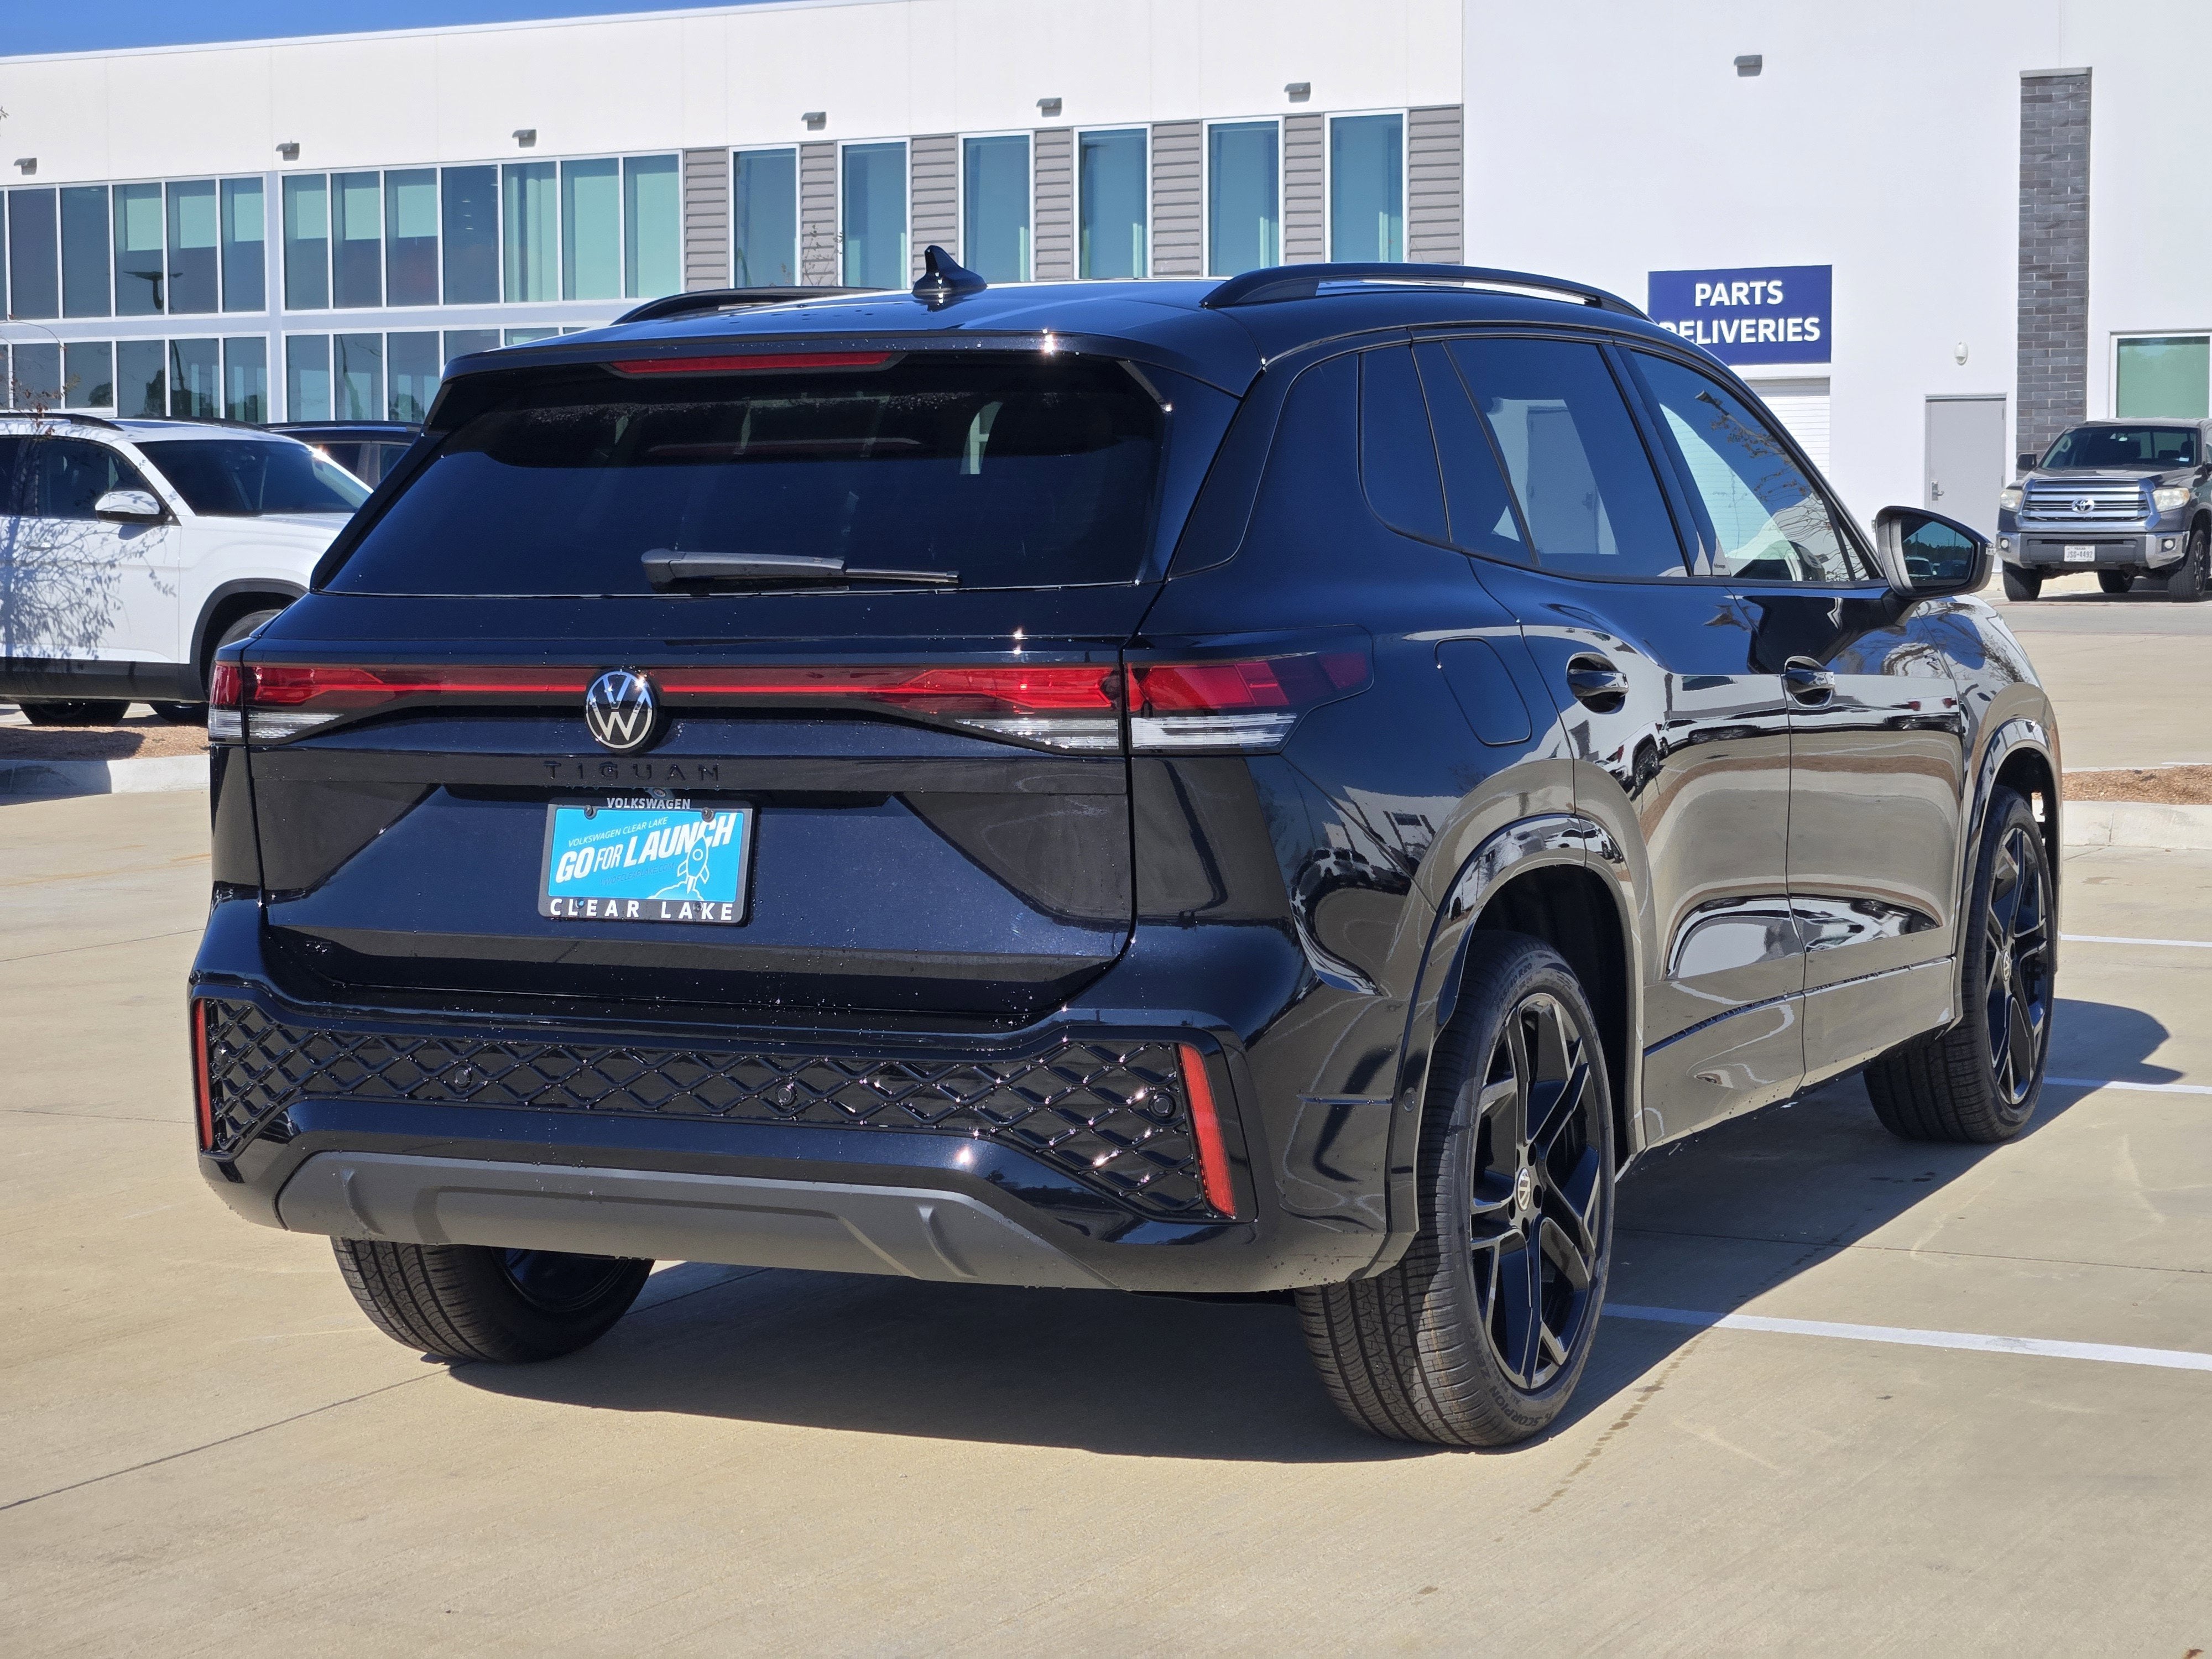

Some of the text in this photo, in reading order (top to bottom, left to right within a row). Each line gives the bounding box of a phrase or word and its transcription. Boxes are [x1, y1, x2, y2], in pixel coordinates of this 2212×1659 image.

[1694, 280, 1783, 306] PARTS
[543, 760, 719, 781] TIGUAN
[606, 797, 691, 810] VOLKSWAGEN
[568, 816, 669, 847] VOLKSWAGEN CLEAR LAKE
[555, 813, 737, 883] GO FOR LAUNCH
[550, 898, 733, 921] CLEAR LAKE
[1489, 1385, 1543, 1427] SCORPION
